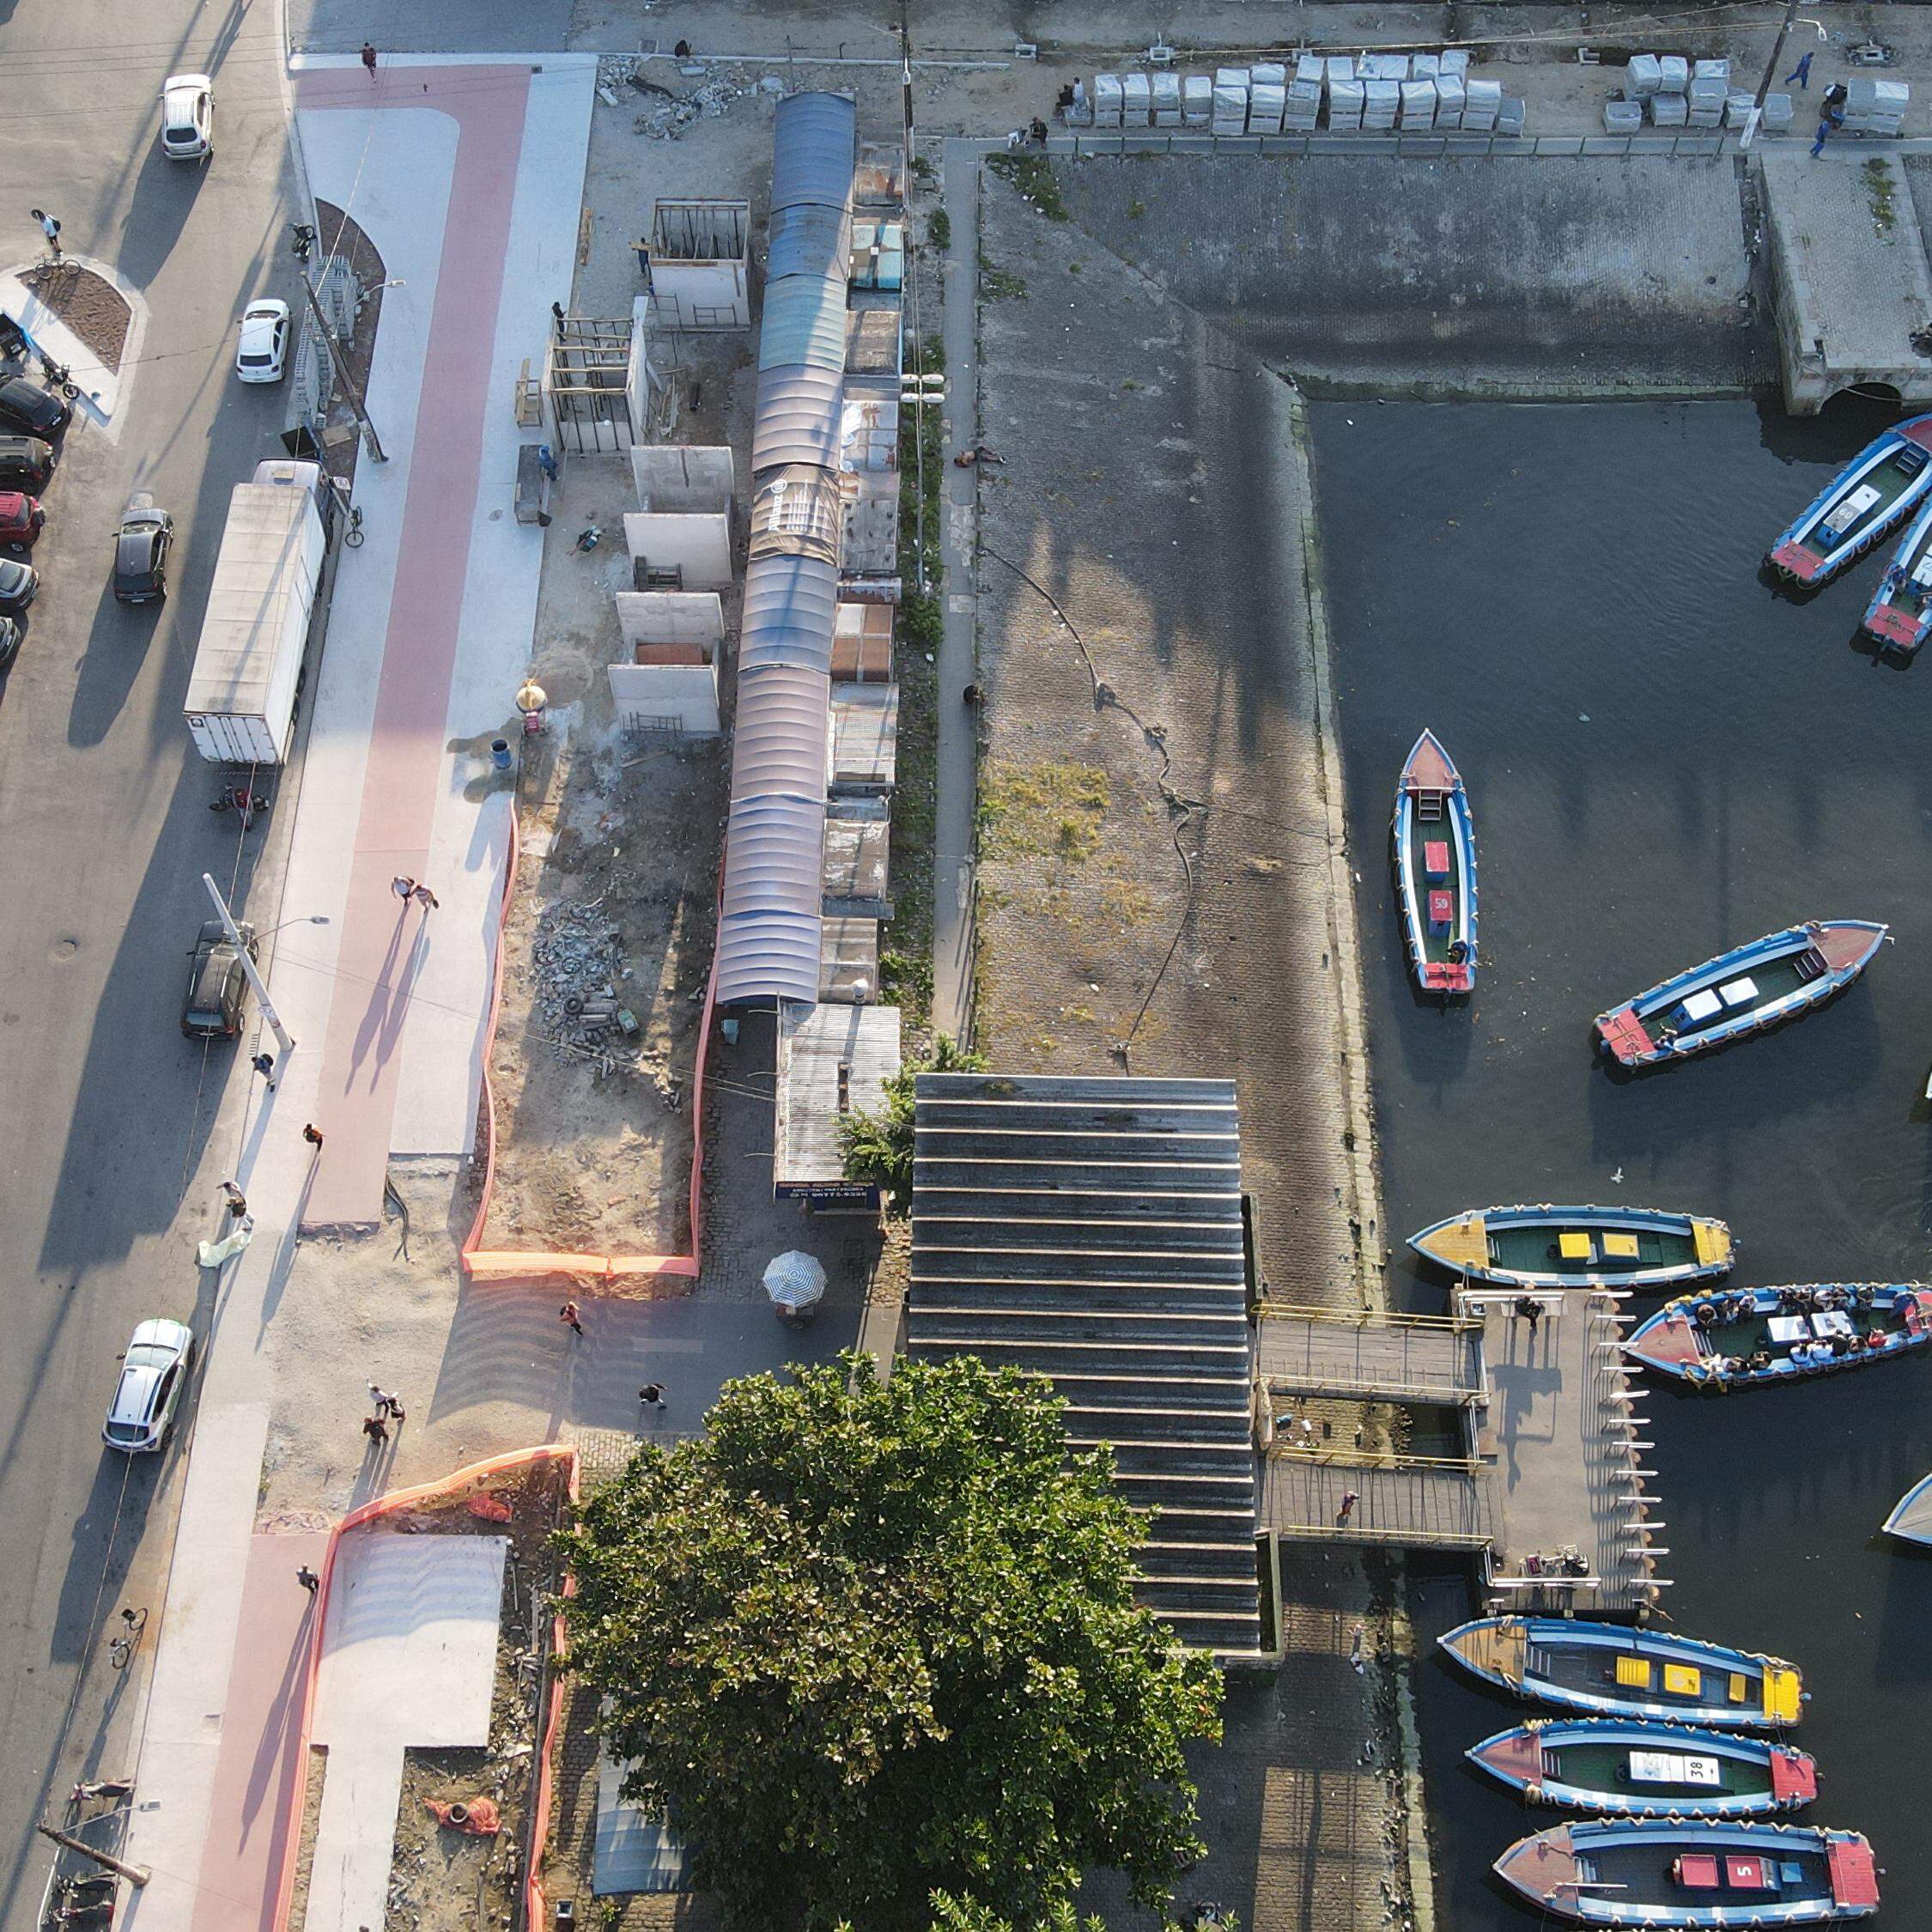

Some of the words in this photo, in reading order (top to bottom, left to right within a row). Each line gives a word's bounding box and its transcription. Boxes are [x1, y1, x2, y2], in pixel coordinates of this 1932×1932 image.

[768, 494, 783, 532] Allianz
[1838, 507, 1853, 519] 60
[1690, 1761, 1704, 1778] 38
[1736, 1866, 1753, 1876] 5
